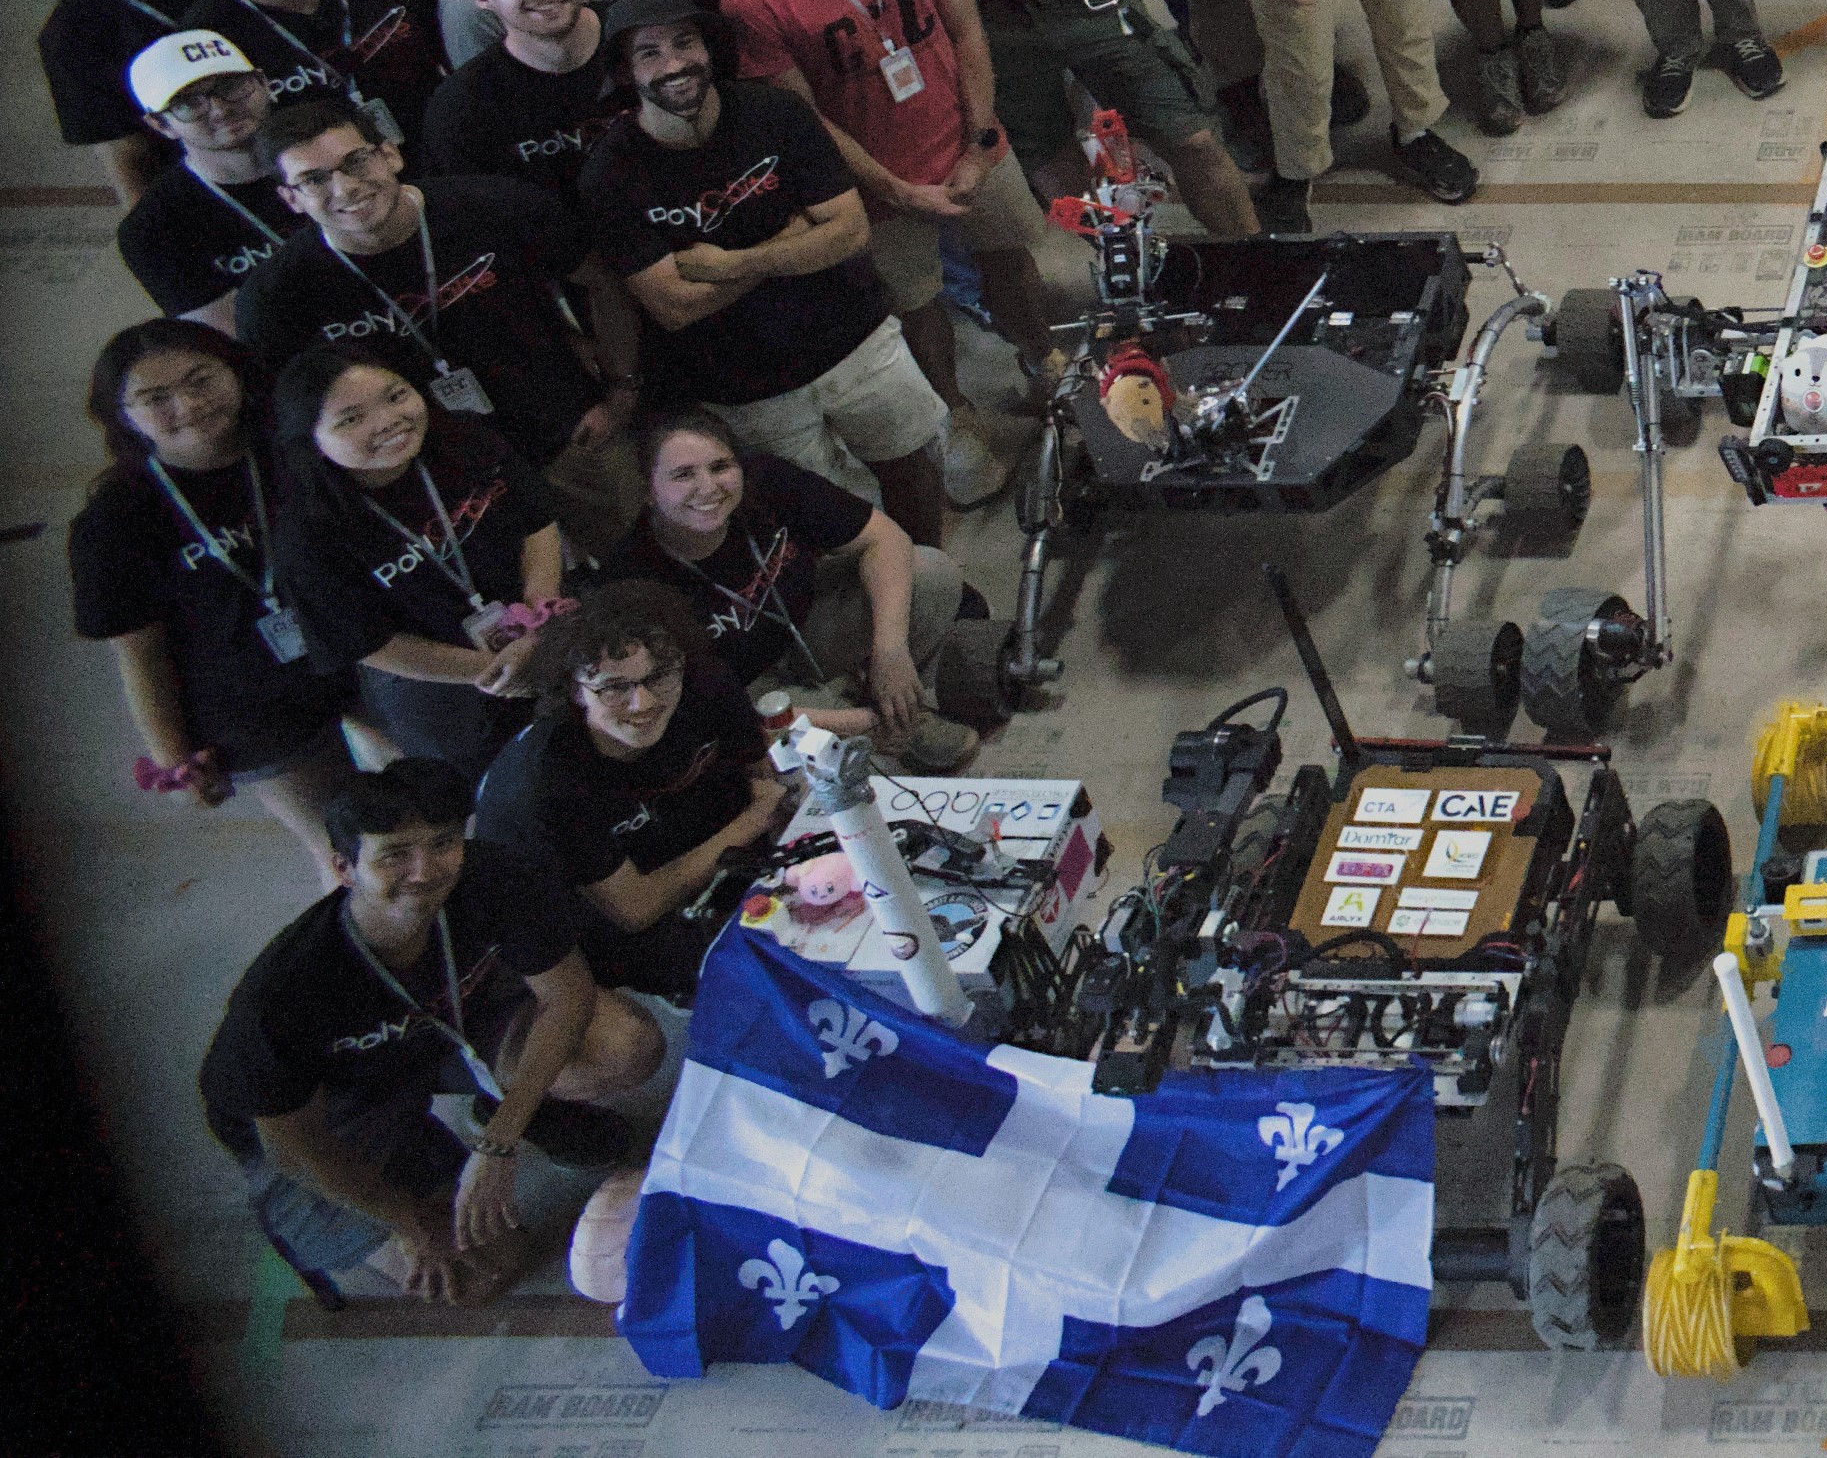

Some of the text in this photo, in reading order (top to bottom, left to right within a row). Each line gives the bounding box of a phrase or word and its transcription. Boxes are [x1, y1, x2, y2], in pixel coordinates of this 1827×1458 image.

[183, 38, 233, 63] CIC
[182, 523, 255, 571] Ply
[1363, 800, 1396, 814] CTA
[1440, 794, 1513, 819] CAE
[494, 1387, 659, 1421] RAM BOARD
